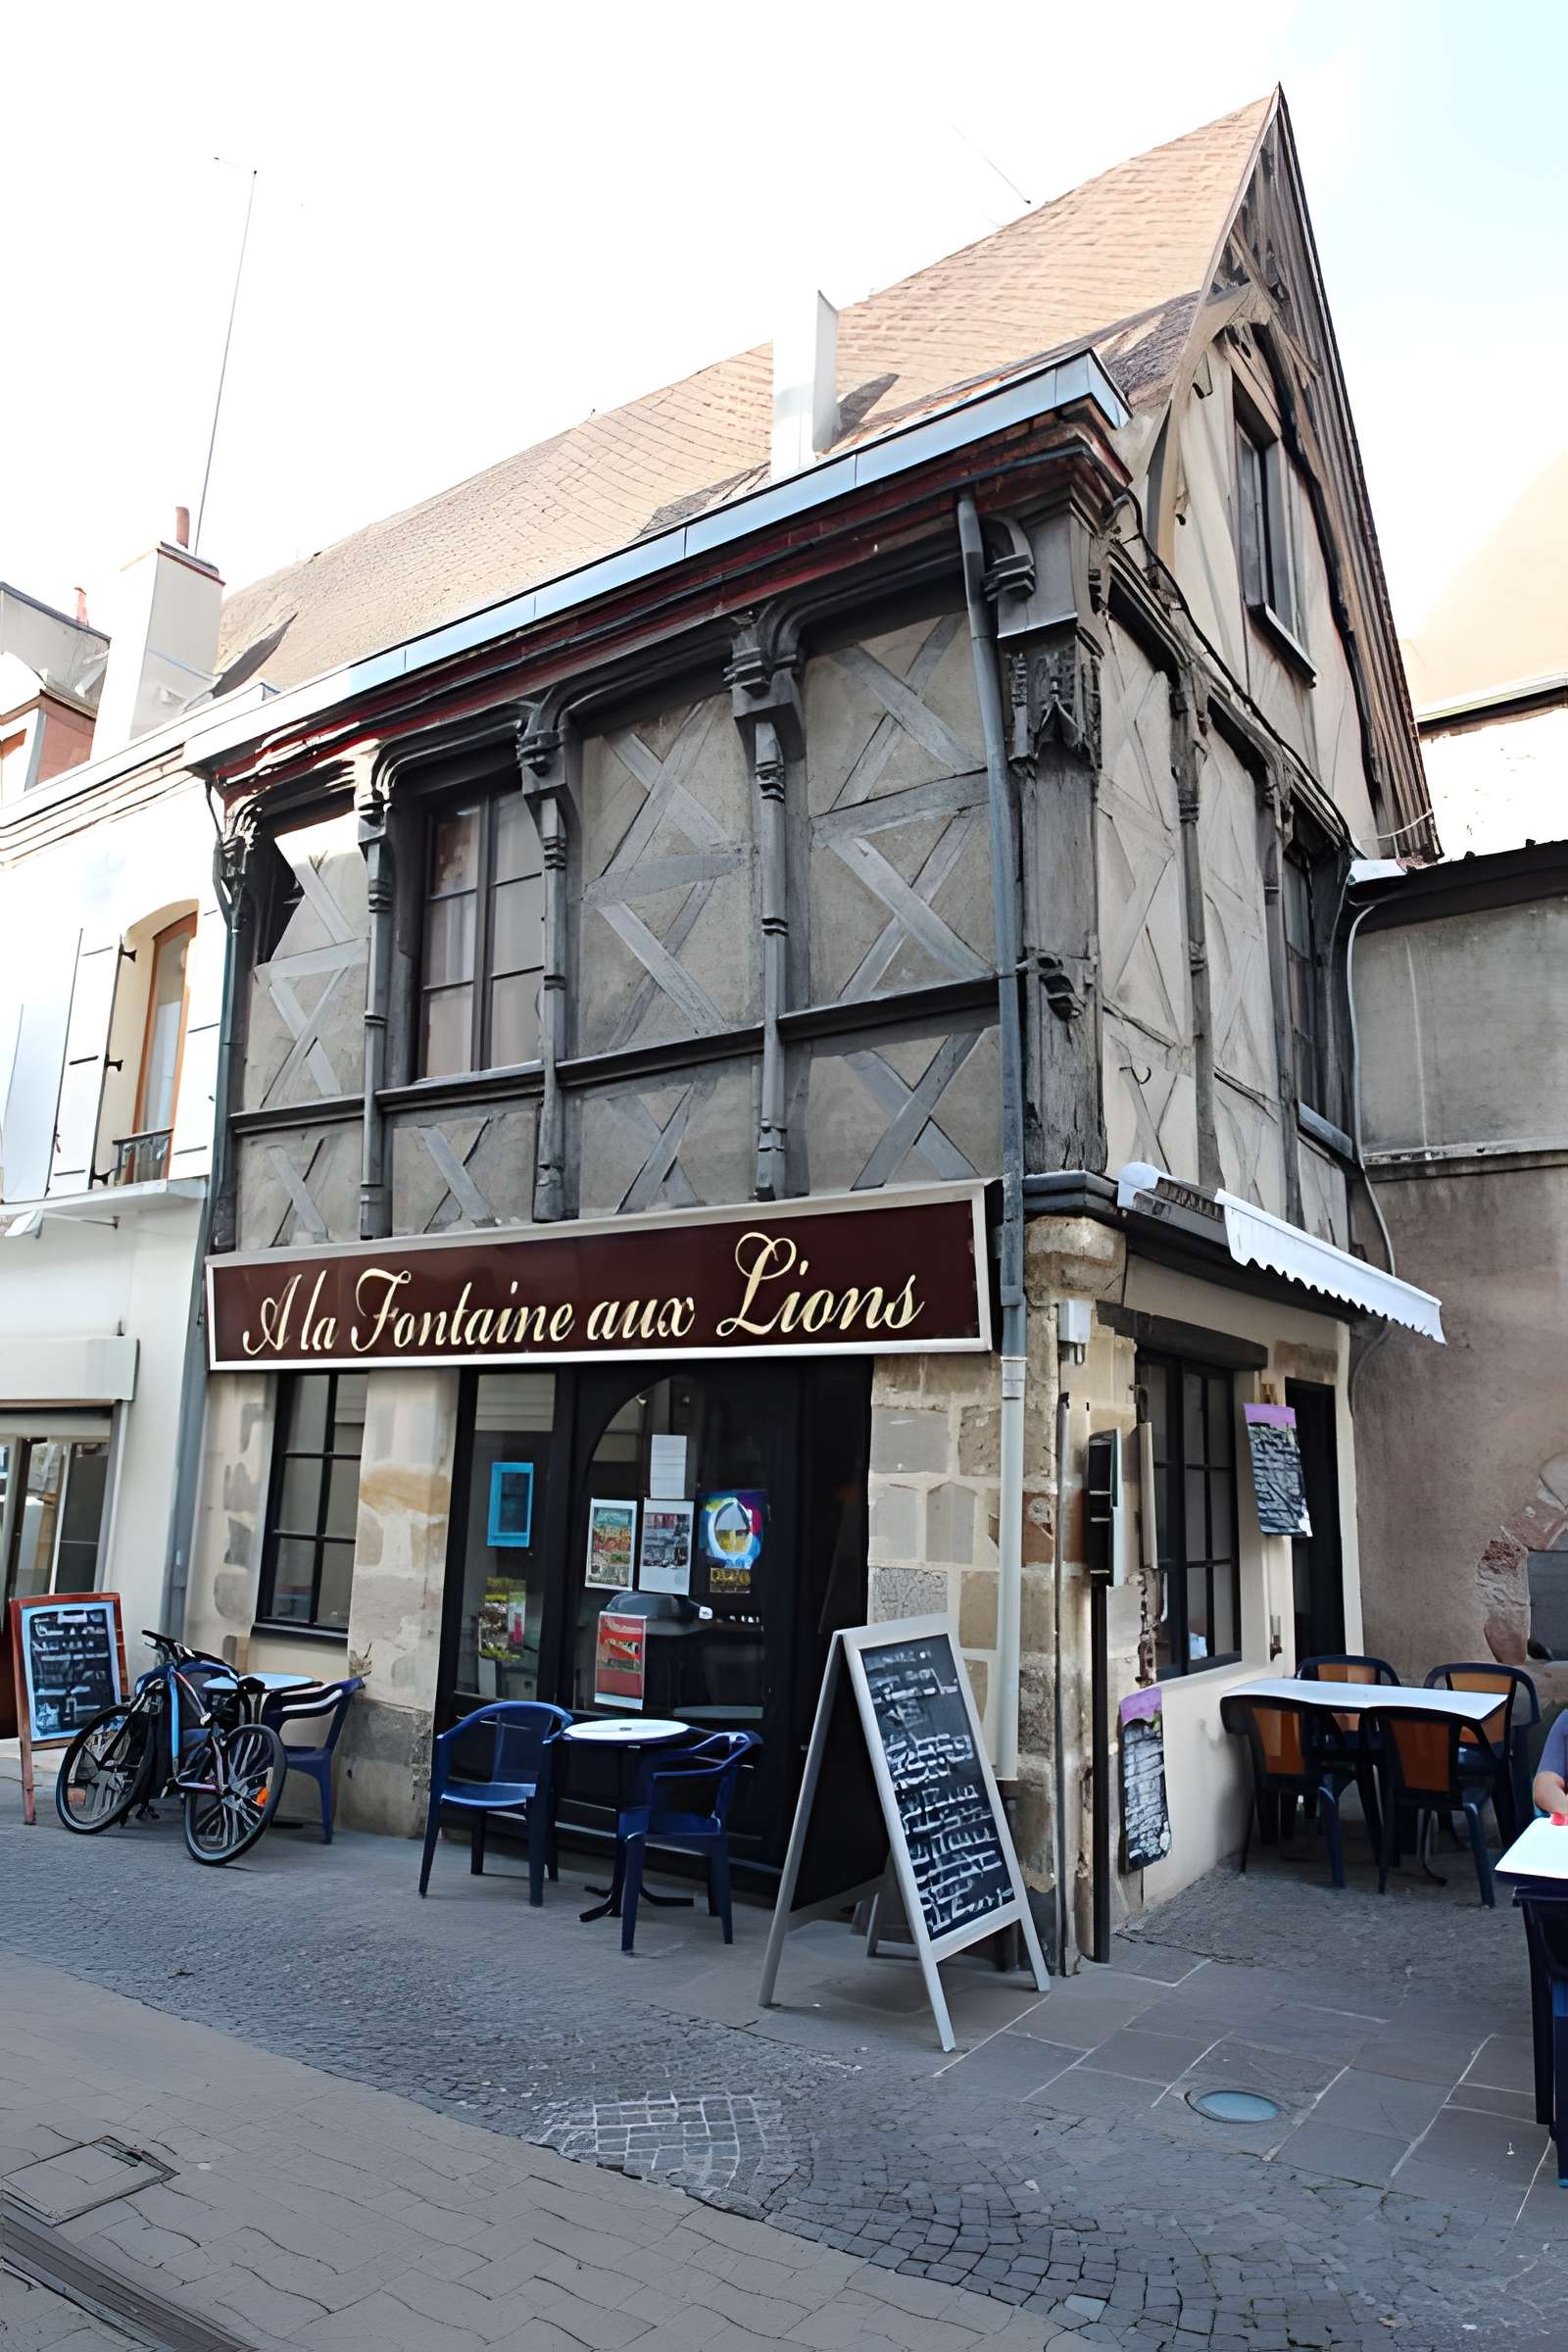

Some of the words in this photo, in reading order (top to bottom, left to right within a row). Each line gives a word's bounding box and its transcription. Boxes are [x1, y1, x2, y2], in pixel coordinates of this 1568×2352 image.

[243, 1273, 303, 1355] A
[300, 1269, 337, 1351] la
[350, 1267, 574, 1352] Fontaine
[586, 1297, 696, 1342] aux
[715, 1231, 925, 1337] Lions
